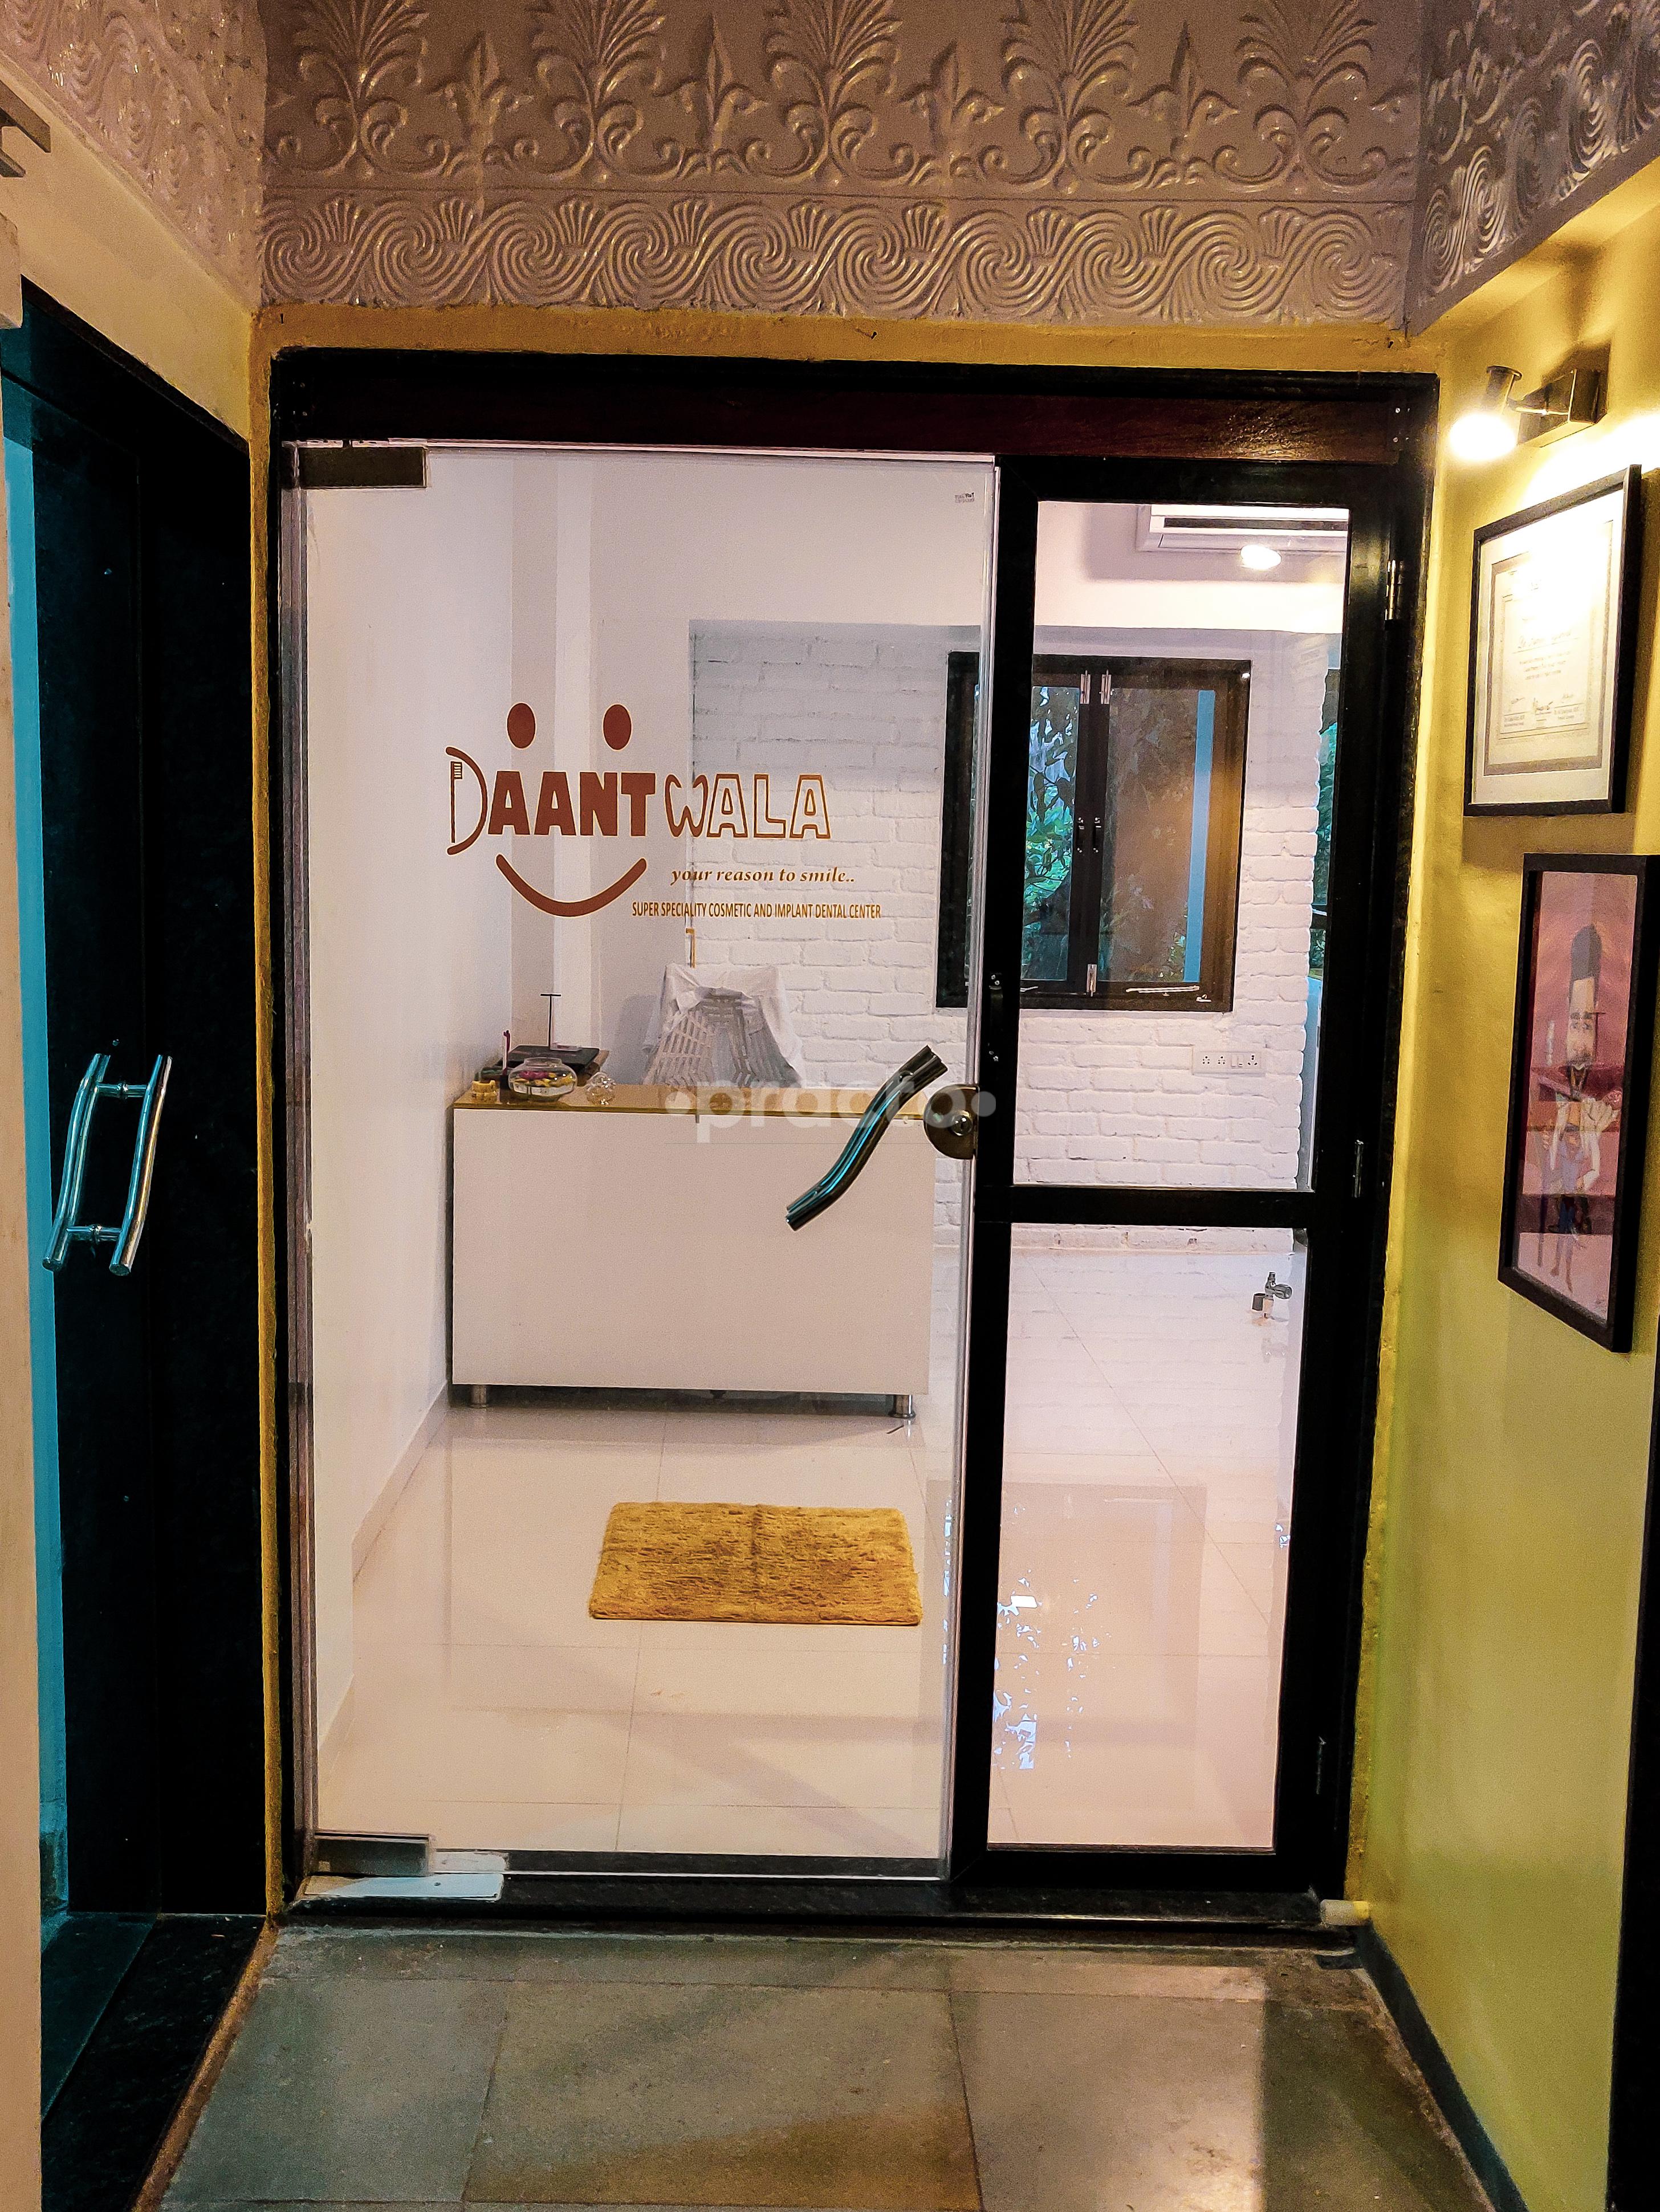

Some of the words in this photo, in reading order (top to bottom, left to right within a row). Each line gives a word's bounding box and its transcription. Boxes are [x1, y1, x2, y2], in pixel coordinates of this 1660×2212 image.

[670, 869, 713, 886] your
[717, 869, 774, 882] reason
[779, 868, 796, 882] to
[632, 902, 659, 917] SUPER
[661, 902, 707, 917] SPECIALITY
[709, 903, 752, 918] COSMETIC
[753, 903, 772, 918] AND
[775, 903, 813, 918] IMPLANT
[815, 904, 847, 918] DENTAL
[849, 904, 881, 919] CENTER
